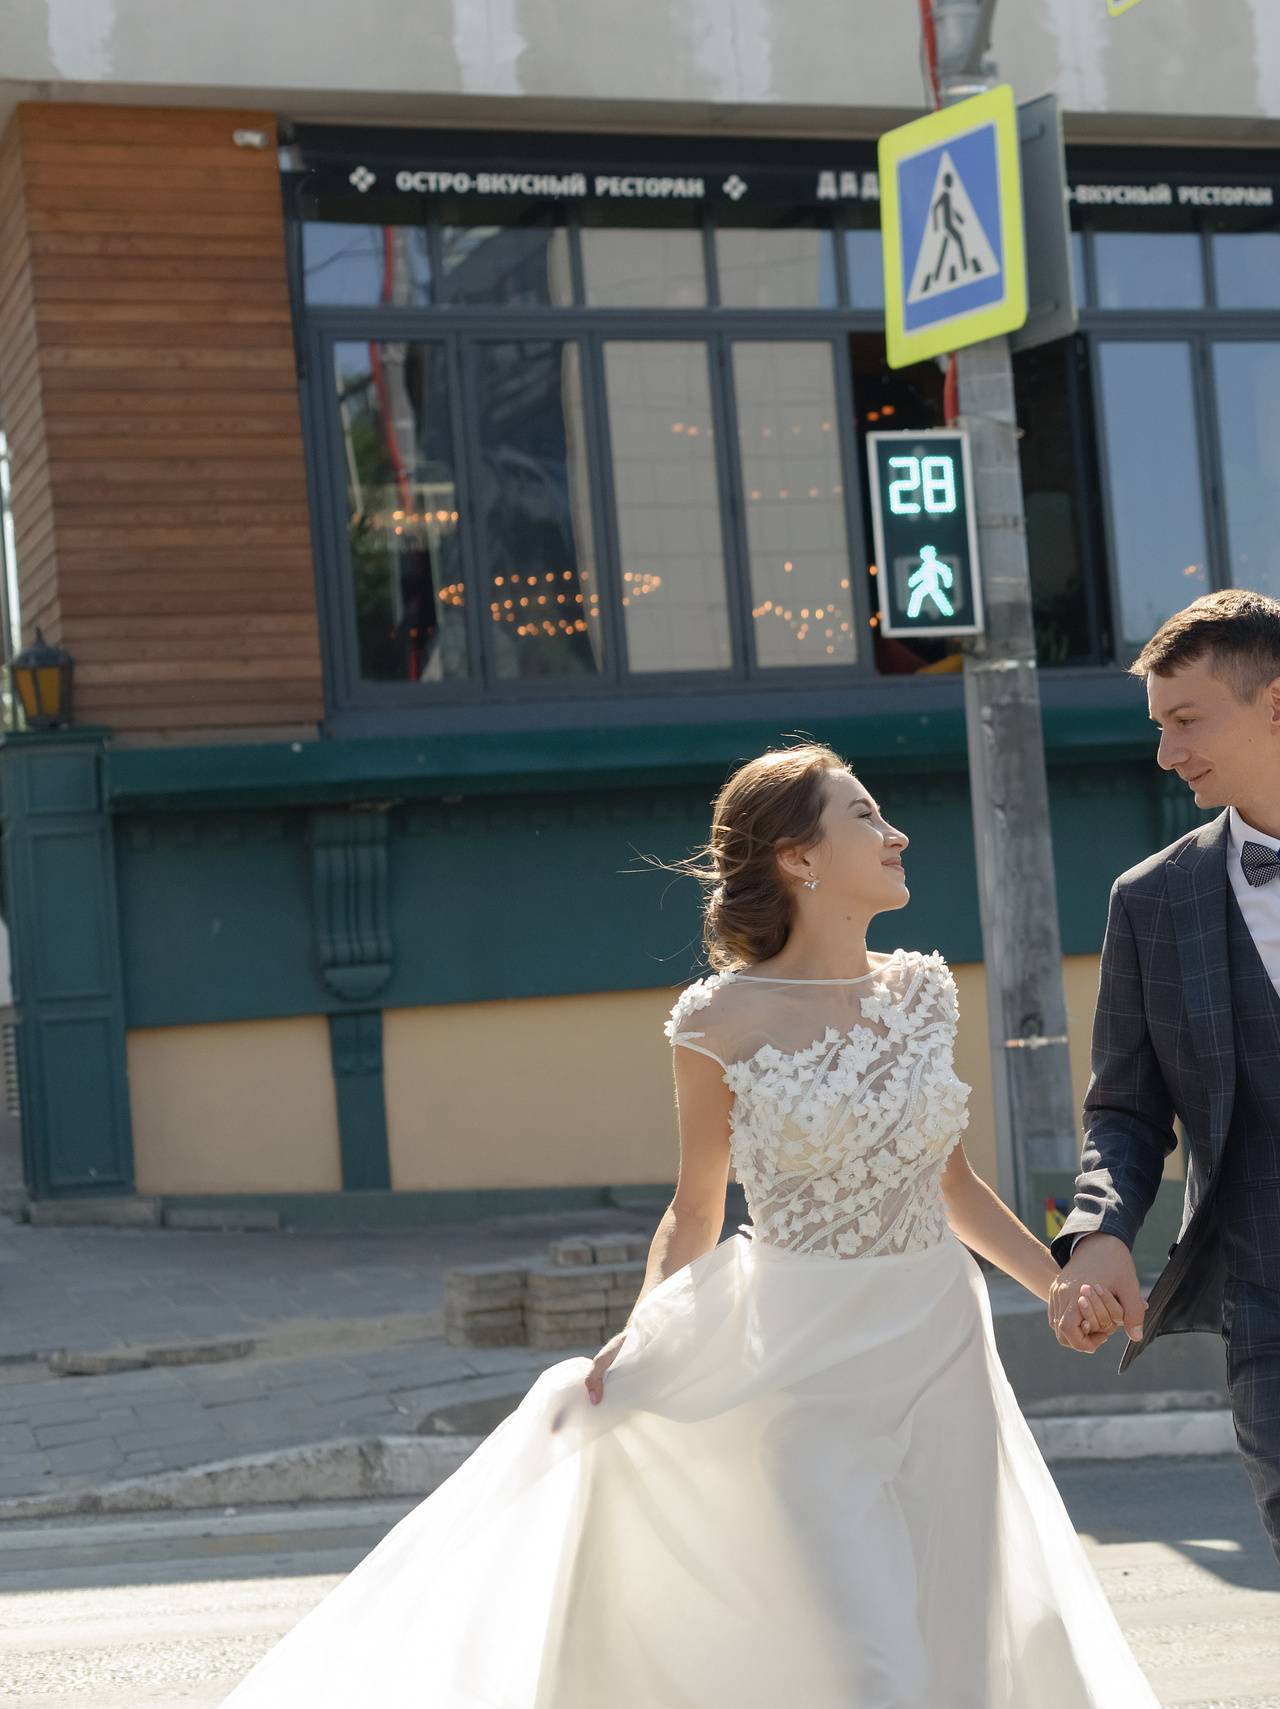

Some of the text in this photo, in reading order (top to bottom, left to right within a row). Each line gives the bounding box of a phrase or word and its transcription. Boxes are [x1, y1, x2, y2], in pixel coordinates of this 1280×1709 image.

[395, 171, 705, 199] ОСТРО-ВКУСНЫЙ РЕСТОРАН
[1177, 186, 1273, 206] РЕСТОРАН
[888, 456, 957, 514] 28
